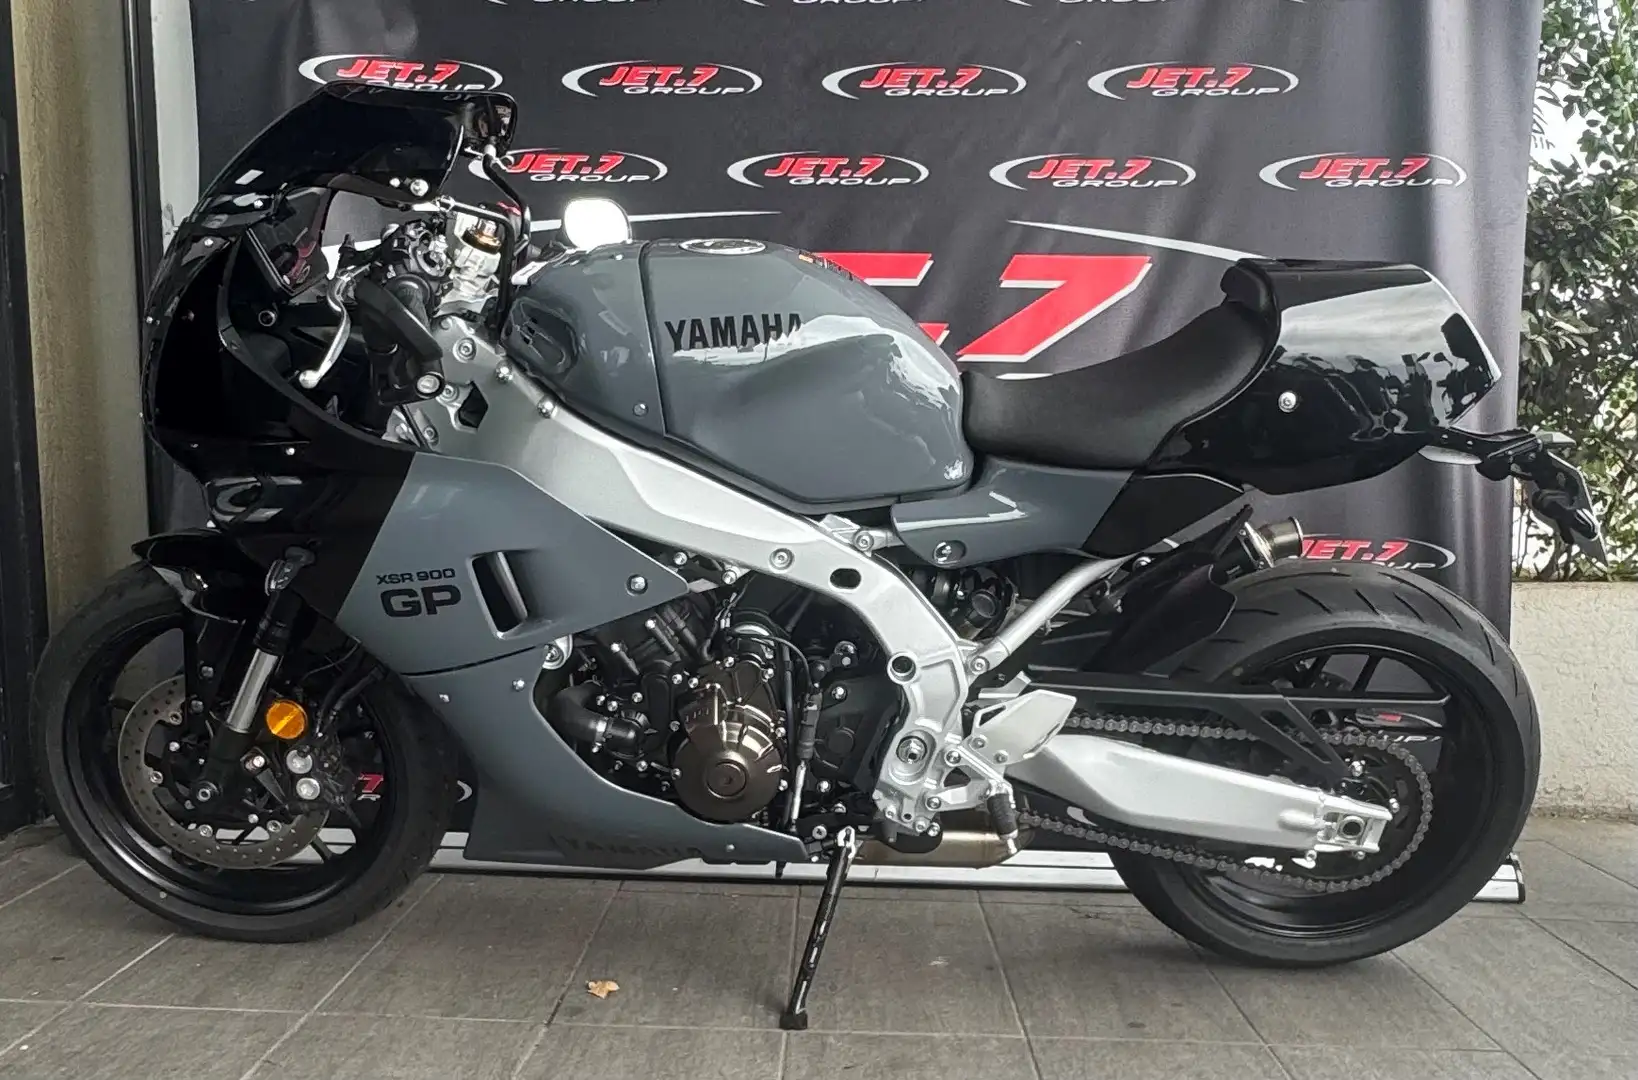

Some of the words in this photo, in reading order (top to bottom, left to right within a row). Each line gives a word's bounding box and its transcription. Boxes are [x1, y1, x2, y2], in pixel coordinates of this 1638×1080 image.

[337, 58, 460, 83] JET.7
[599, 66, 719, 87] JET.7
[860, 68, 982, 88] JET.7
[1126, 67, 1253, 88] JET.7
[623, 86, 745, 95] GROUP
[885, 88, 1009, 96] GROUP
[1152, 88, 1280, 97] GROUP
[506, 154, 625, 174] JET.7
[765, 157, 886, 177] JET.7
[1027, 159, 1152, 180] JET.7
[1298, 158, 1430, 179] JET.7
[530, 174, 650, 182] GROUP
[789, 177, 912, 186] GROUP
[1052, 180, 1178, 188] GROUP
[1325, 179, 1454, 188] GROUP
[376, 572, 414, 585] XSR
[416, 568, 456, 582] 900
[380, 584, 462, 618] GP
